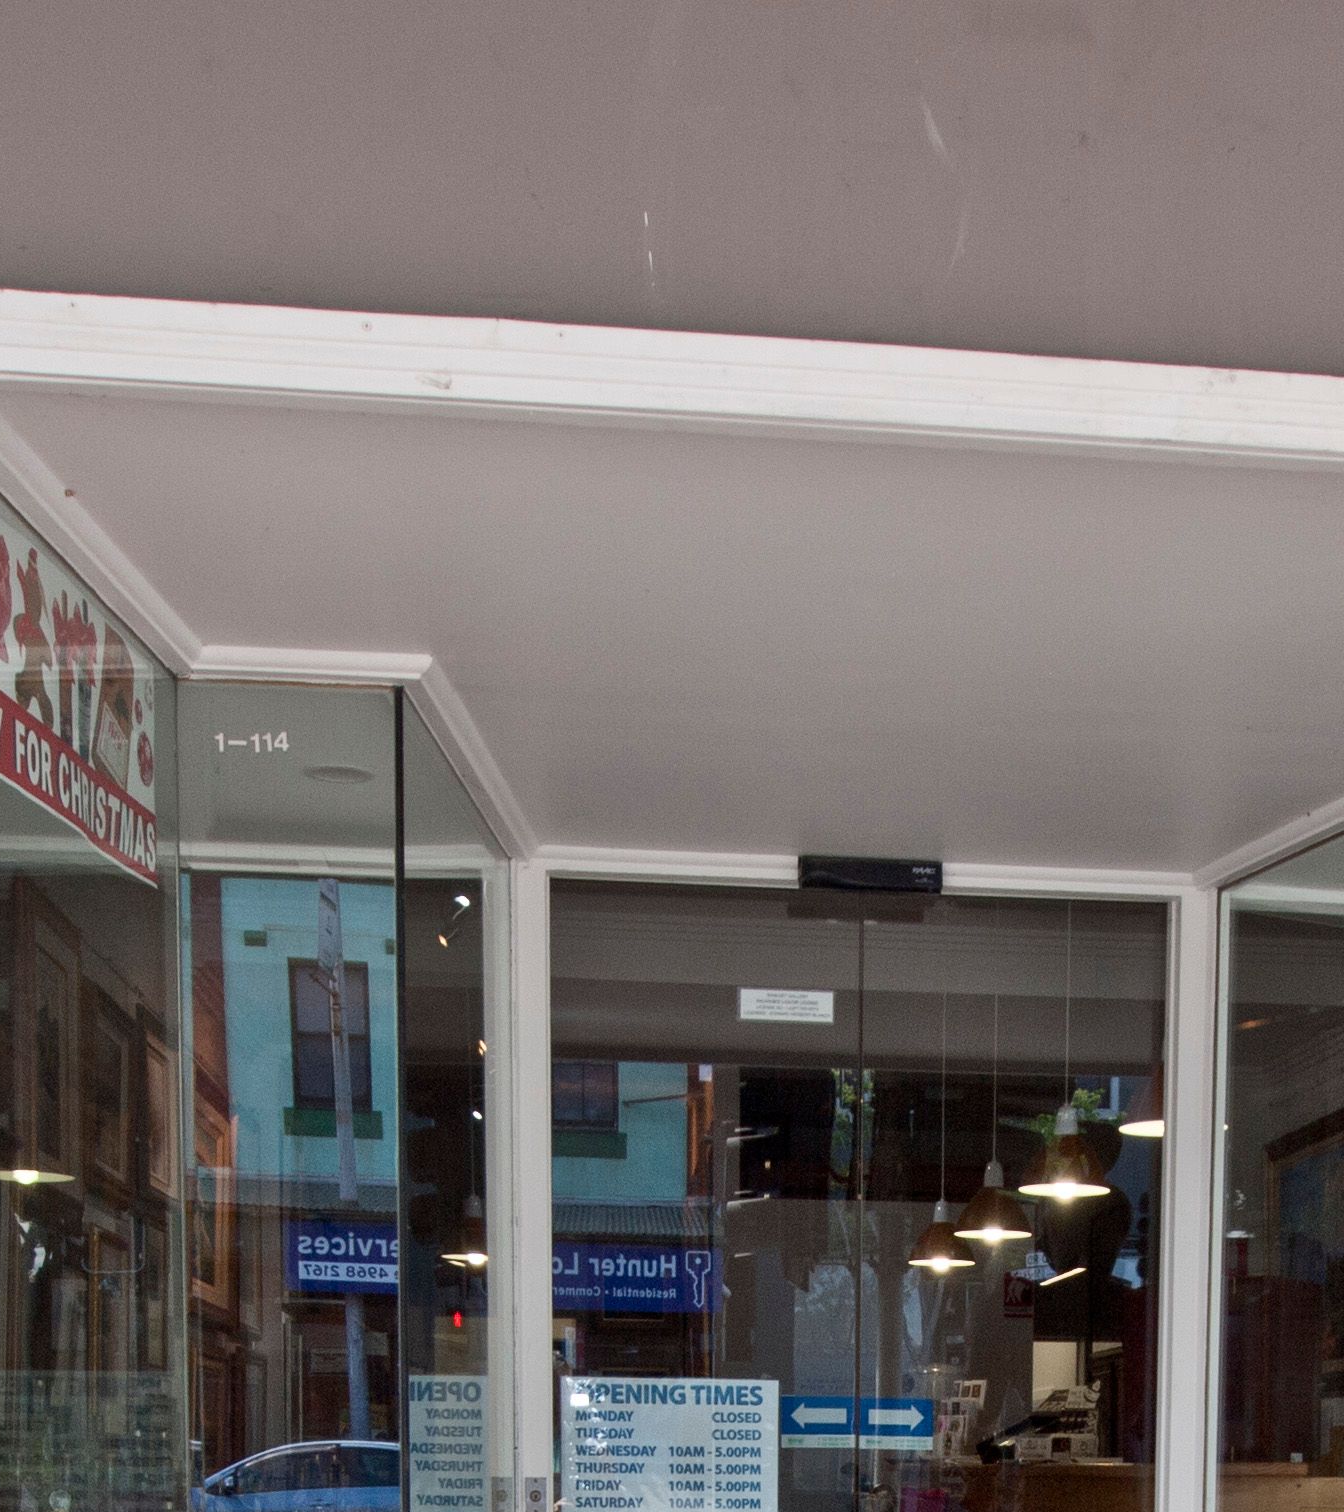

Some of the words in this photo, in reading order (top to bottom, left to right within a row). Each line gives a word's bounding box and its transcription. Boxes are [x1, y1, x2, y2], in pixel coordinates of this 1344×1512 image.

[15, 719, 54, 798] FOR
[58, 756, 157, 874] CHRISTMAS
[690, 1385, 763, 1406] TIMES
[575, 1410, 634, 1422] MONDAY
[711, 1412, 762, 1423] CLOSED
[575, 1428, 634, 1439] TUESDAY
[711, 1429, 762, 1441] CLOSED
[575, 1445, 656, 1457] WEDNESDAY
[668, 1446, 705, 1457] 10AM
[714, 1447, 761, 1458] 5.00PM
[575, 1462, 645, 1474] THURSDAY
[668, 1463, 705, 1474] 10AM
[714, 1464, 761, 1475] 5.00PM
[575, 1479, 622, 1491] FRIDAY
[668, 1480, 705, 1492] 10AM
[714, 1481, 761, 1492] 5.00PM
[575, 1496, 644, 1508] SATURDAY
[668, 1497, 705, 1509] 10AM
[714, 1498, 761, 1510] 5.00PM
